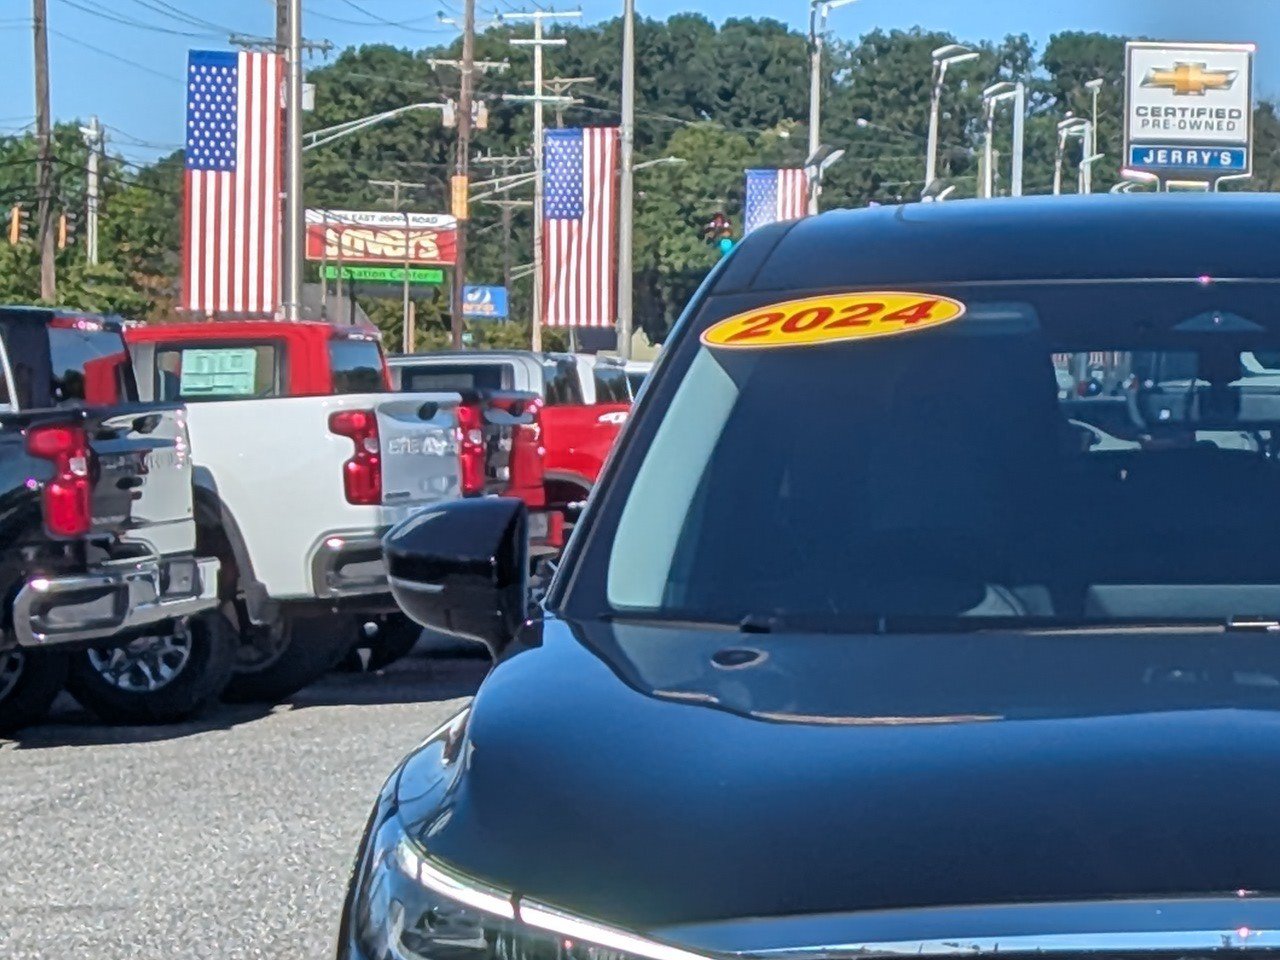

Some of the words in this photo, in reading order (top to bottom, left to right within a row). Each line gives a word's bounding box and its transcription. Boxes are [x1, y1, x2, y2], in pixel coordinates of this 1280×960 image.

[1135, 105, 1242, 120] CERTIFIED
[1140, 119, 1236, 131] PRE-OWNED
[1142, 149, 1232, 165] JERRY'S
[724, 299, 940, 342] 2024
